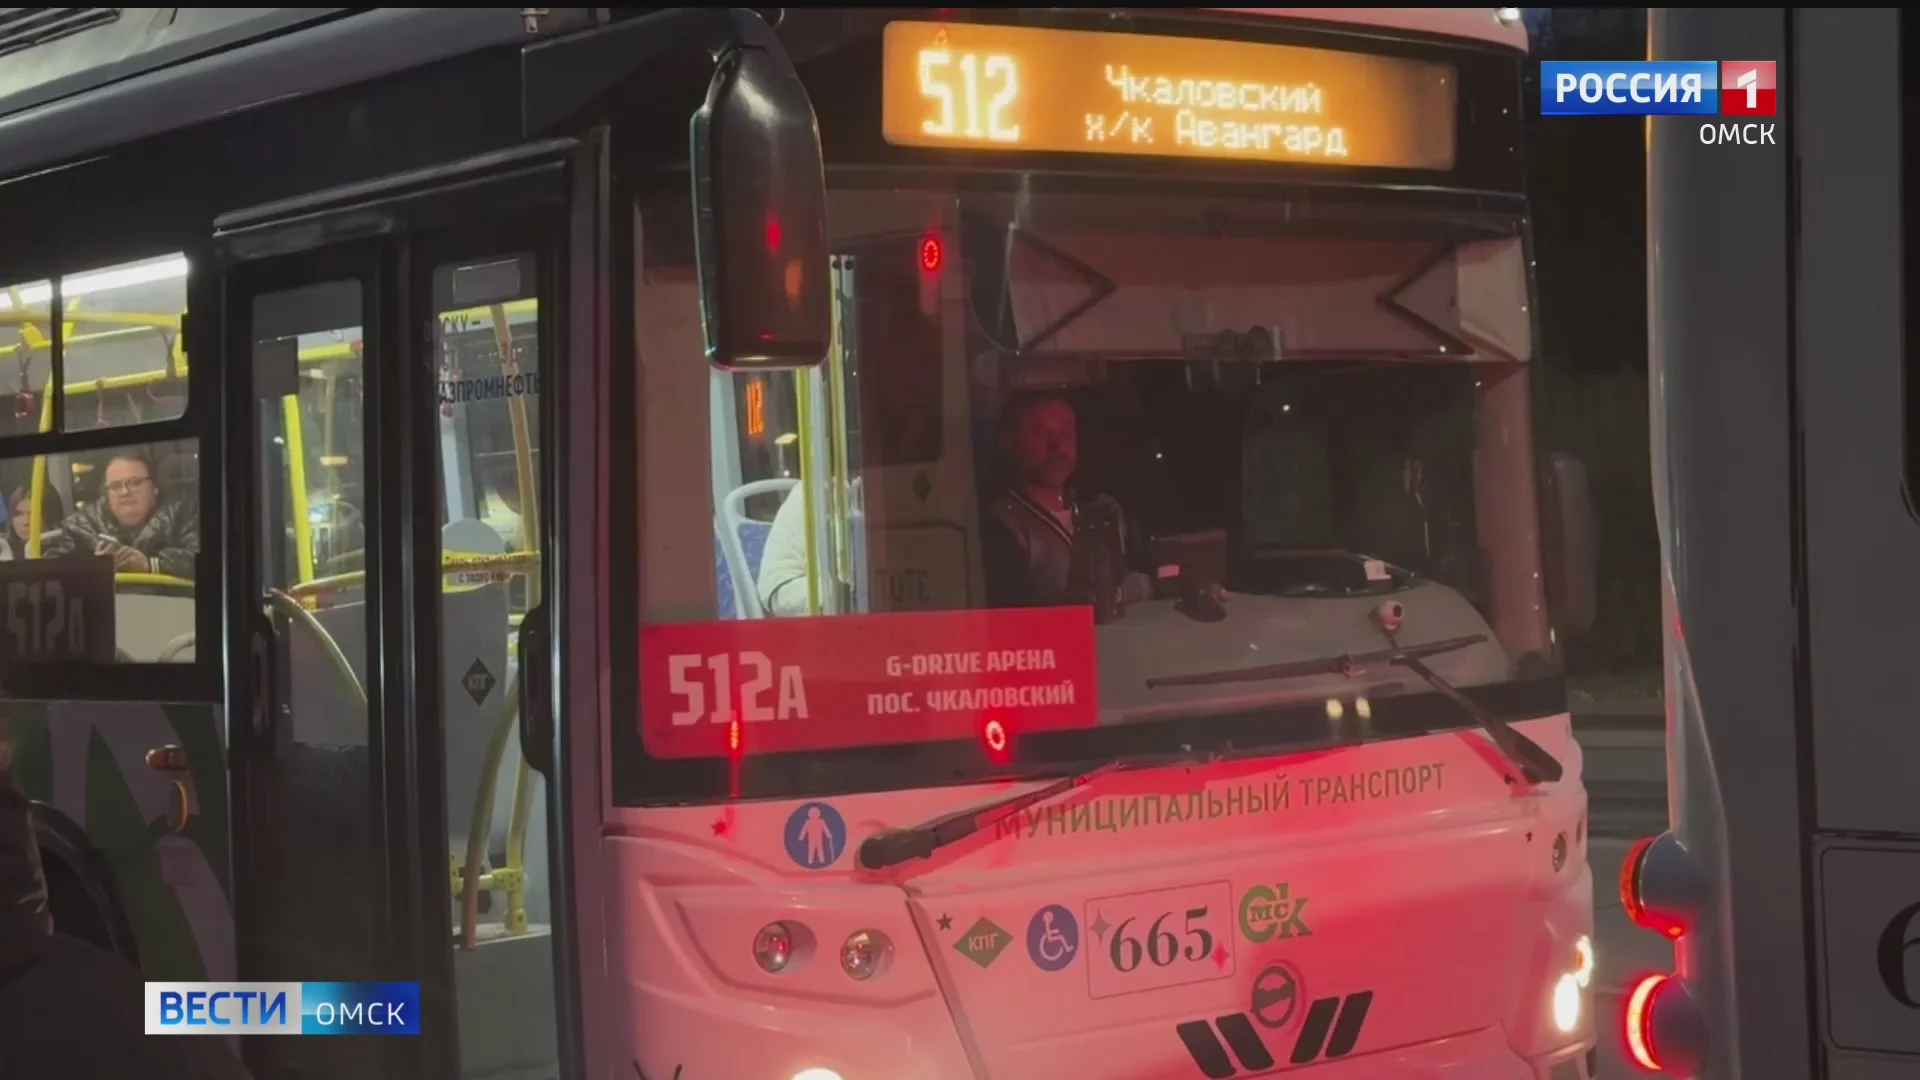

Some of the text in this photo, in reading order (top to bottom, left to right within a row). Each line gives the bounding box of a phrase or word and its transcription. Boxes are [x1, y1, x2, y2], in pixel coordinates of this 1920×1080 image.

[918, 48, 1020, 142] 512
[1104, 64, 1323, 115] Чкаловский
[1085, 110, 1348, 158] х/к Авангард
[436, 372, 540, 404] АЗПРОМНЕФТЬ
[886, 649, 1056, 677] G-DRIVE АРЕНА
[668, 651, 809, 727] 512А
[867, 680, 1075, 716] ПОС. ЧКАЛОВСКИЙ
[995, 763, 1446, 841] МУНИЦИПАЛЬНЫЙ ТРАНСПОРТ
[967, 930, 1000, 954] КПГ
[1109, 905, 1213, 974] 665
